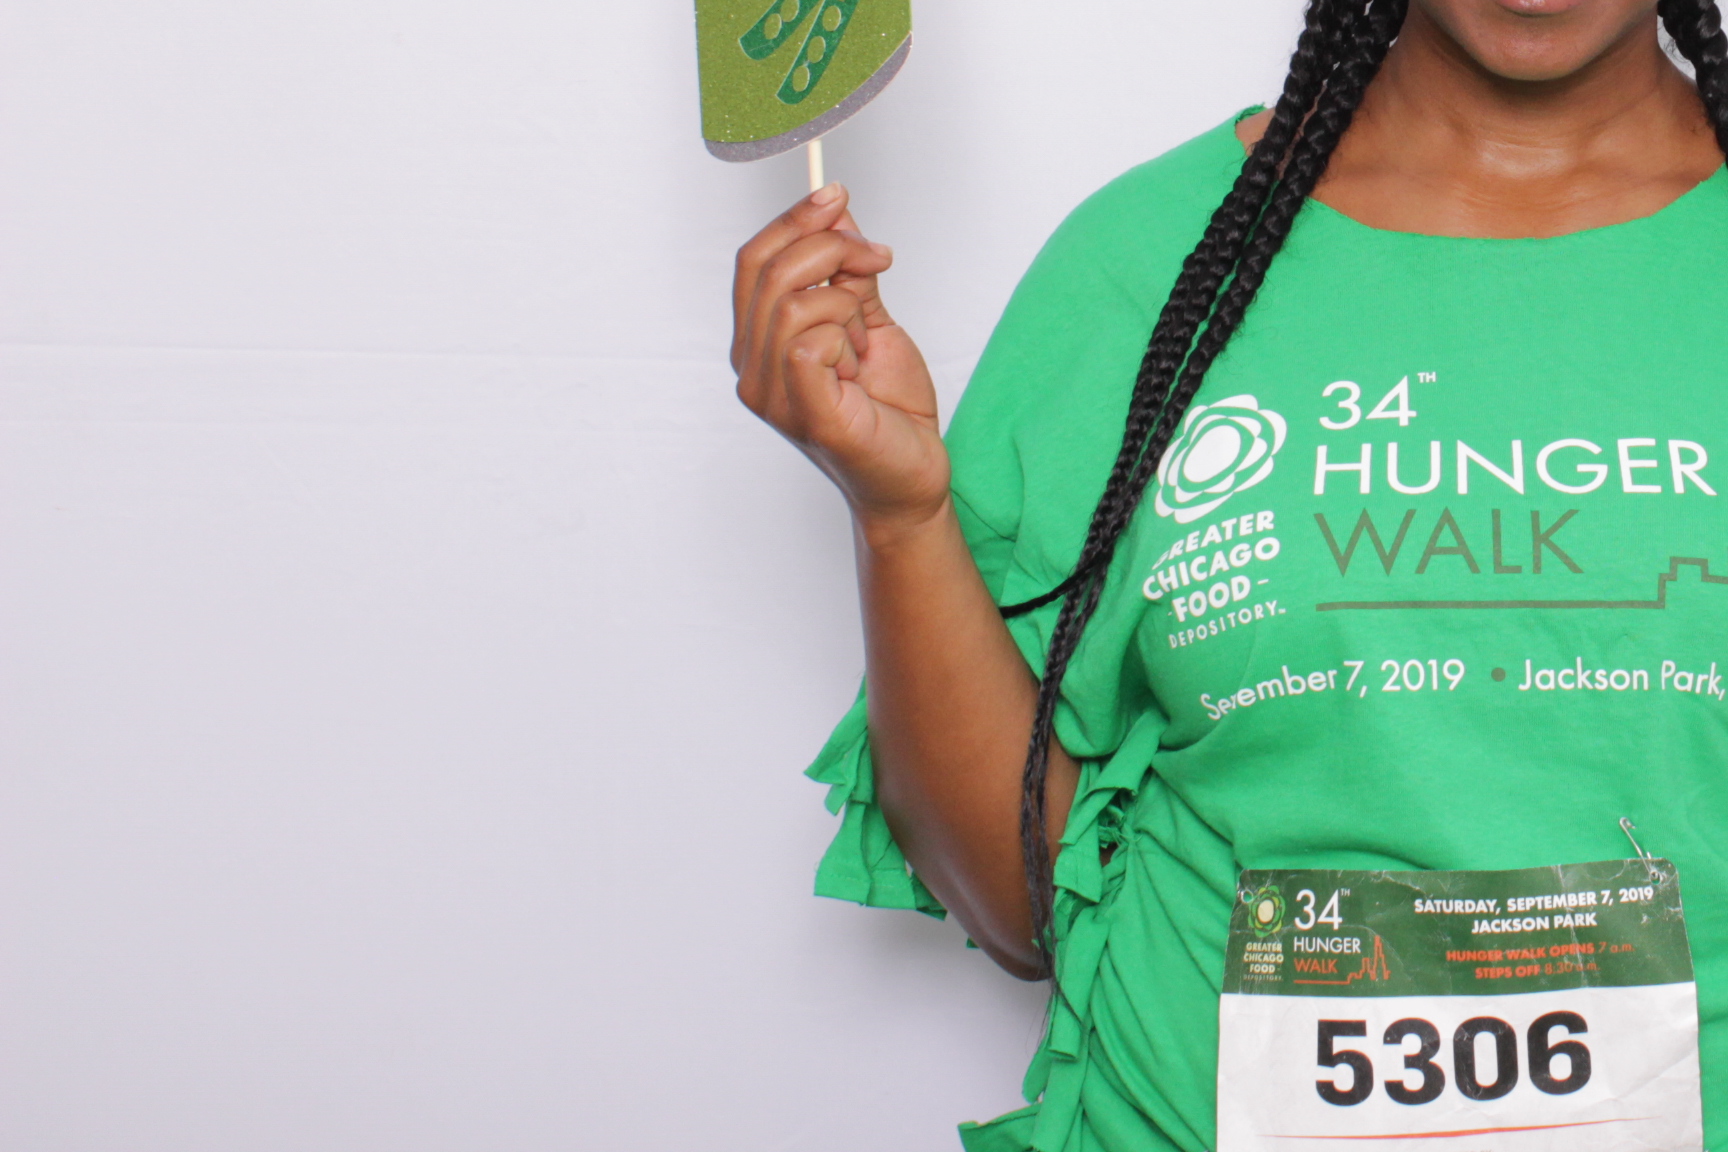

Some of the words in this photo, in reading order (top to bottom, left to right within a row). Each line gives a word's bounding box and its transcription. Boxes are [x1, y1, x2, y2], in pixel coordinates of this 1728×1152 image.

[1313, 438, 1718, 496] HUNGER
[1151, 510, 1275, 571] GREATER
[1313, 506, 1585, 578] WALK
[1142, 536, 1281, 601] CHICAGO
[1200, 665, 1338, 721] Seember
[1343, 660, 1368, 698] 7,
[1380, 658, 1466, 691] 2019
[1517, 656, 1649, 691] Jackson
[1661, 659, 1725, 700] Park,
[1414, 898, 1501, 915] SATURDAY,
[1507, 891, 1598, 913] SEPTEMBER
[1600, 889, 1614, 906] 7,
[1618, 885, 1655, 904] 2019
[1471, 915, 1550, 935] JACKSON
[1553, 912, 1598, 929] PARK
[1243, 951, 1284, 964] CHICAGO
[1245, 941, 1283, 953] GREATER
[1293, 936, 1362, 954] HUNGER
[1446, 949, 1504, 963] HUNGER
[1505, 947, 1547, 960] WALK
[1549, 942, 1595, 957] OPENS
[1599, 941, 1607, 954] 7
[1610, 943, 1636, 953] a.m.
[1293, 957, 1339, 975] WALK
[1475, 965, 1513, 980] STEPS
[1515, 963, 1541, 978] OFF
[1315, 1010, 1593, 1108] 5306
